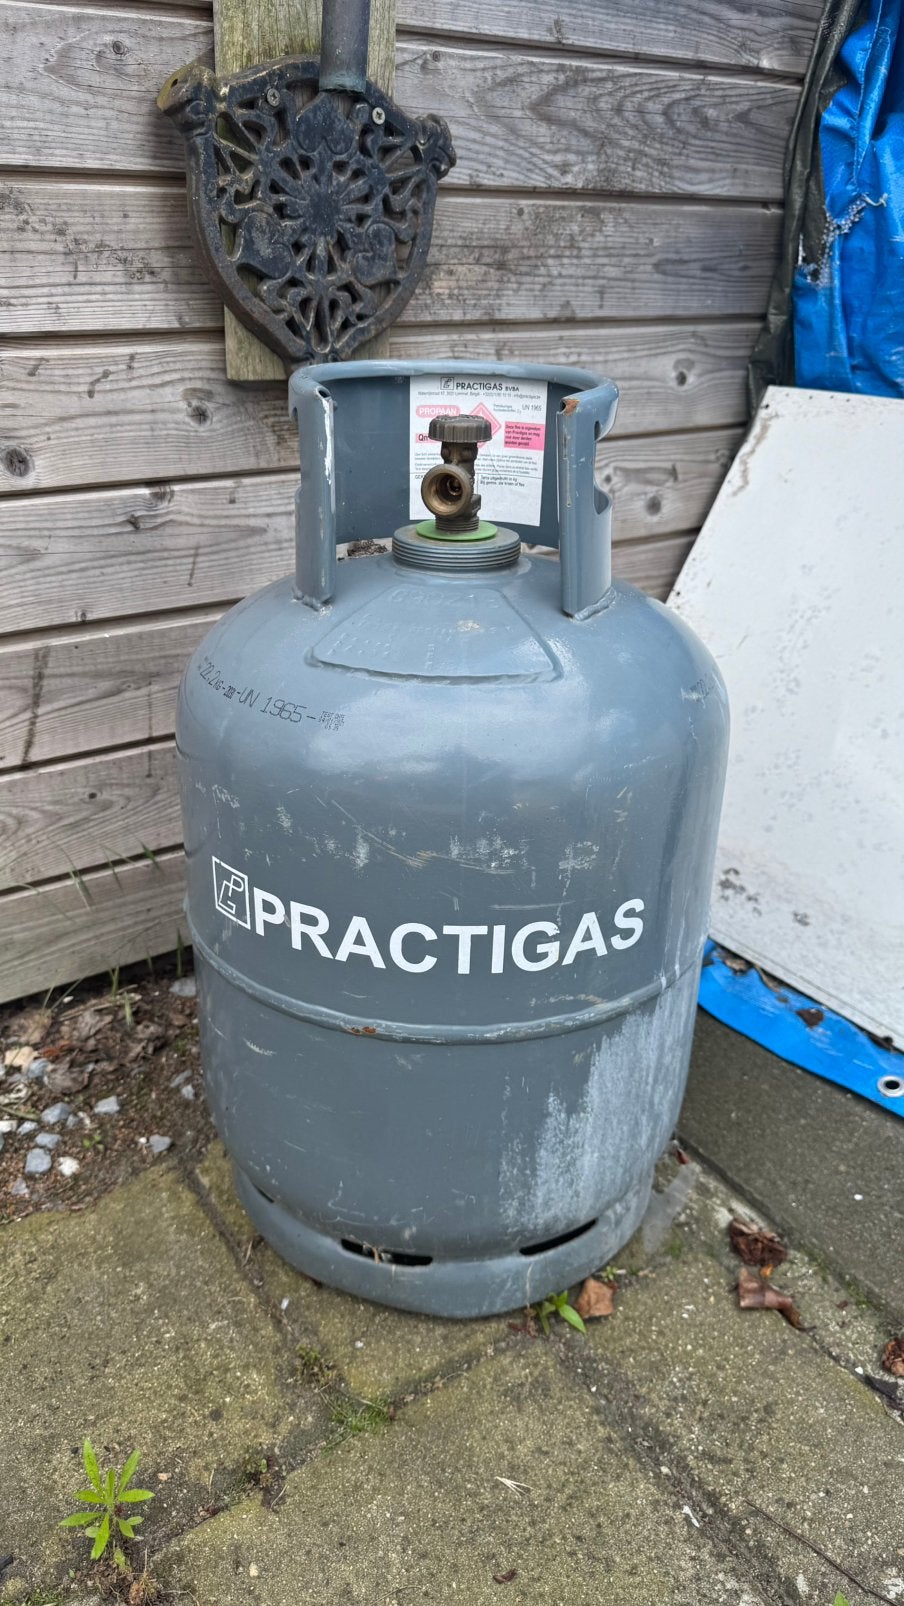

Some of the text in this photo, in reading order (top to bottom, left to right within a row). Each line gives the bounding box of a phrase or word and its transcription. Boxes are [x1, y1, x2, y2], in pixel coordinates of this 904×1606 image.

[455, 382, 503, 391] PRACTIGAS
[419, 407, 457, 416] PROPAAN
[531, 404, 542, 412] 1965
[259, 696, 308, 723] 1965
[252, 886, 645, 975] PRACTIGAS
